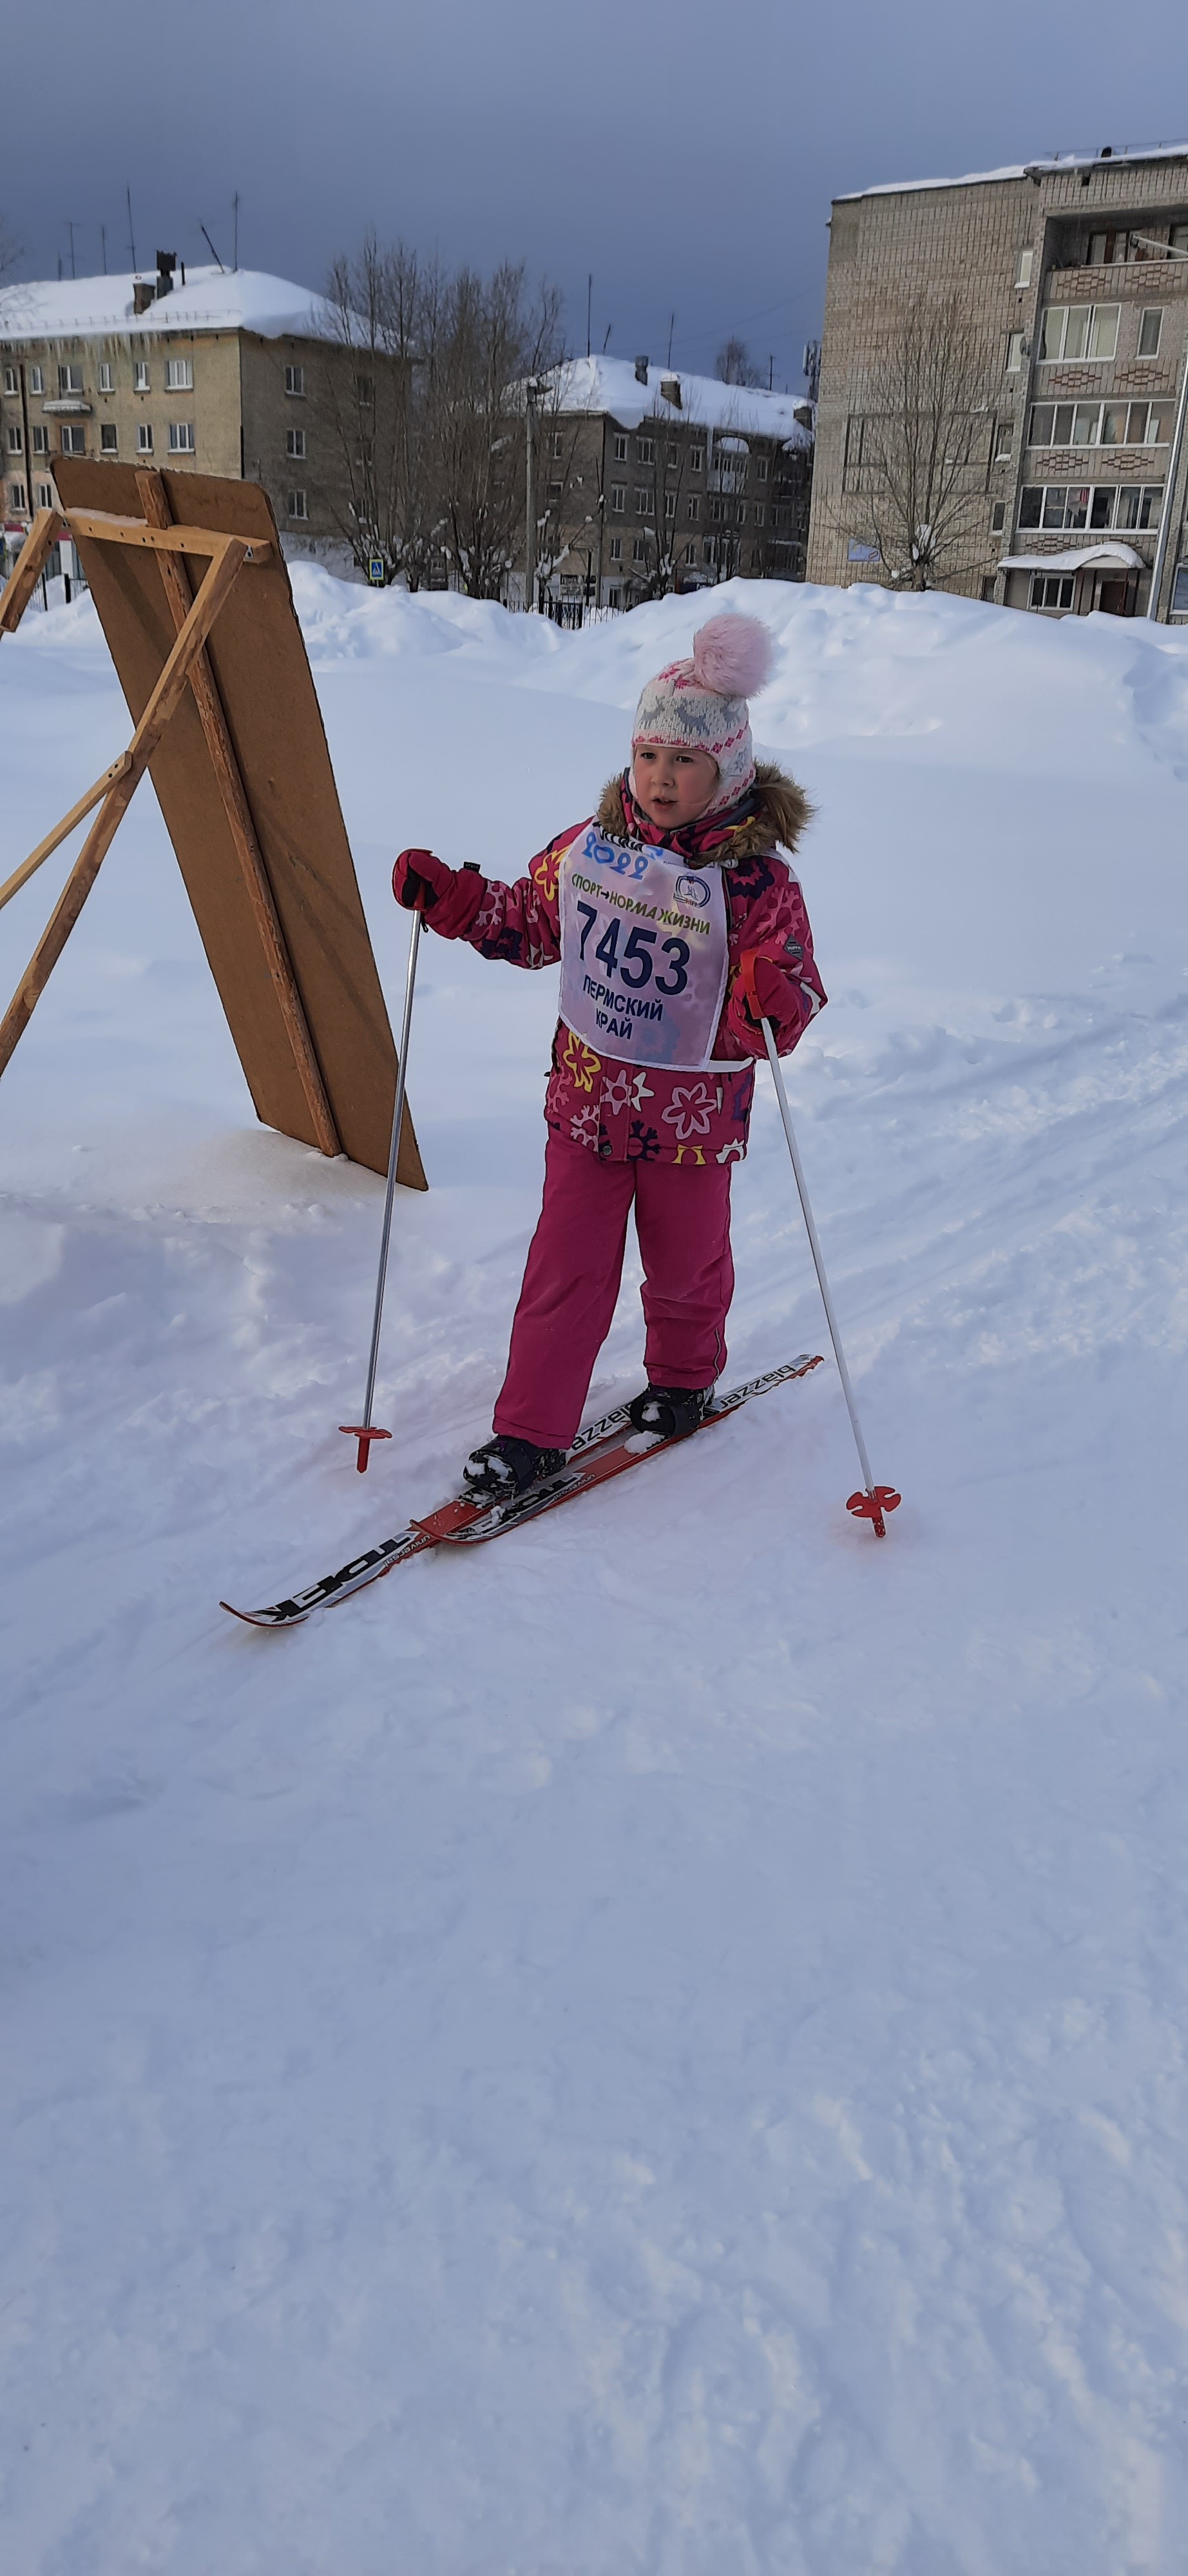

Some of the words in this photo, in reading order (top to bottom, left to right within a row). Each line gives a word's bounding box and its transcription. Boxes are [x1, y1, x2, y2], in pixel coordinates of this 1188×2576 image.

[581, 831, 649, 880] 2022
[571, 873, 602, 898] СПОРТ
[609, 891, 656, 920] НОРМА
[658, 909, 711, 935] ЖИЗНИ
[577, 900, 691, 996] 7453
[582, 974, 664, 1021] ПЕРМСКИЙ
[595, 1007, 633, 1040] КРАЙ
[720, 1363, 796, 1409] blazzer
[383, 1535, 431, 1567] universal
